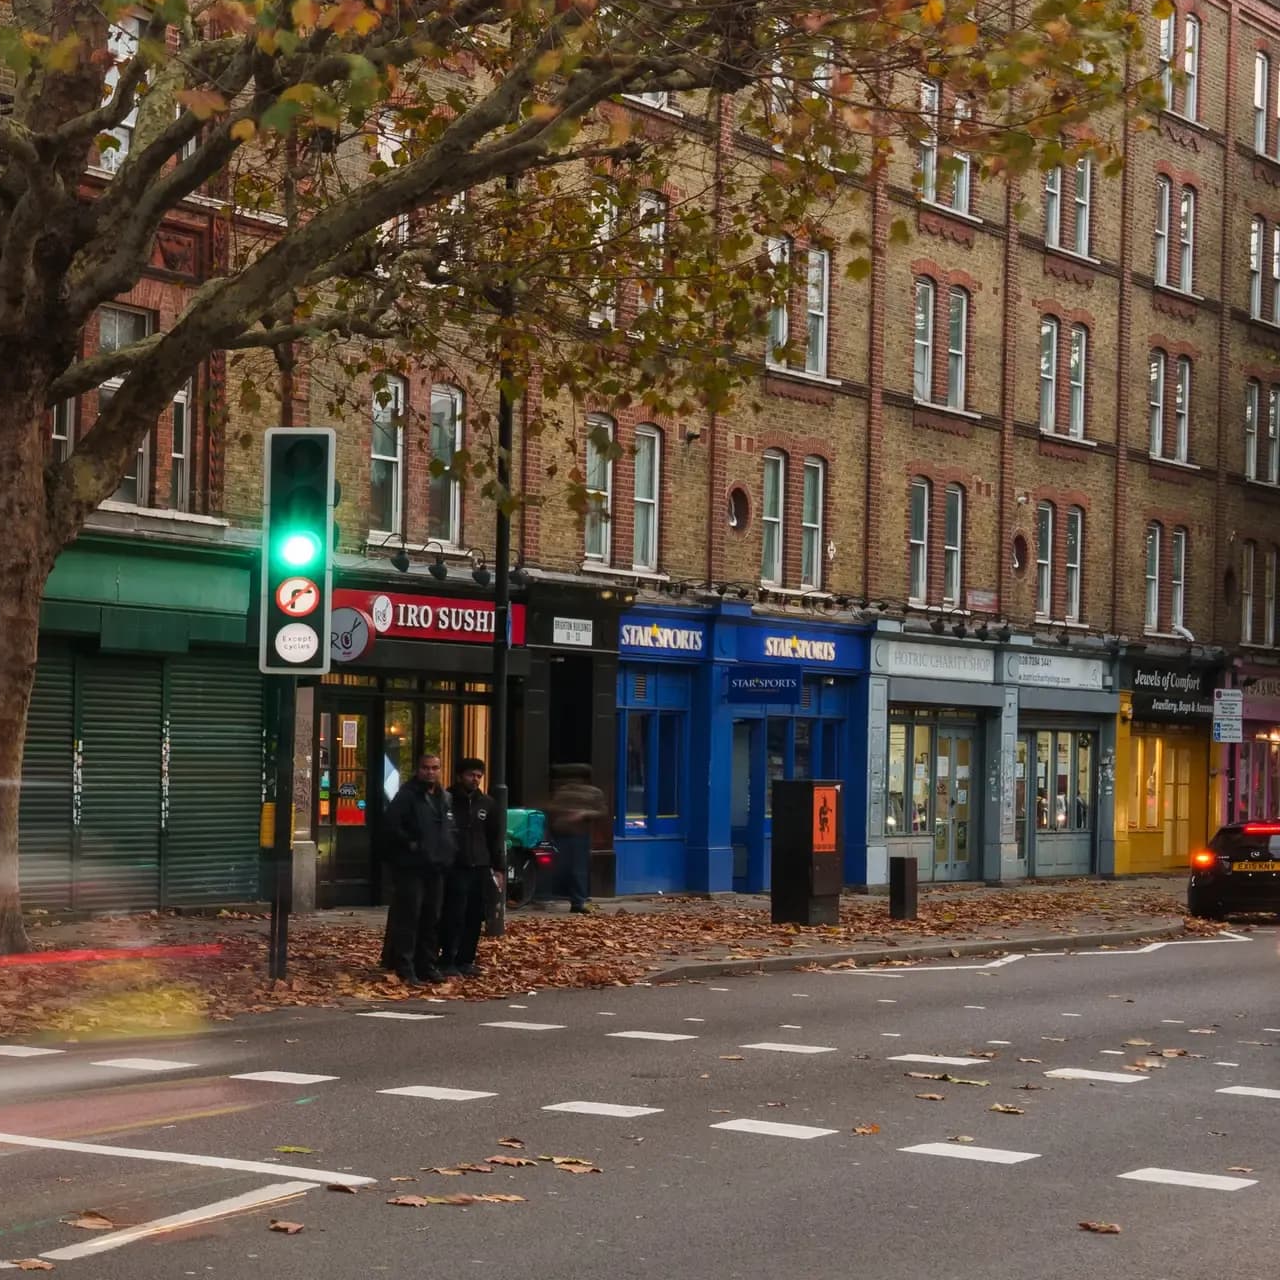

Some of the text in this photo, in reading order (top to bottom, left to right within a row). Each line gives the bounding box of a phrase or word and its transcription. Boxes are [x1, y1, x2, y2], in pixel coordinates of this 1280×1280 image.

[397, 603, 496, 633] IRO SUSHI
[331, 631, 353, 650] RO
[621, 624, 703, 651] STAR SPORTS
[765, 636, 836, 661] STAR SPORTS
[929, 654, 968, 670] CHARITY
[969, 655, 992, 673] SHOP
[731, 679, 797, 688] STAR SPORTS
[1134, 669, 1200, 693] Jewels of Comfort
